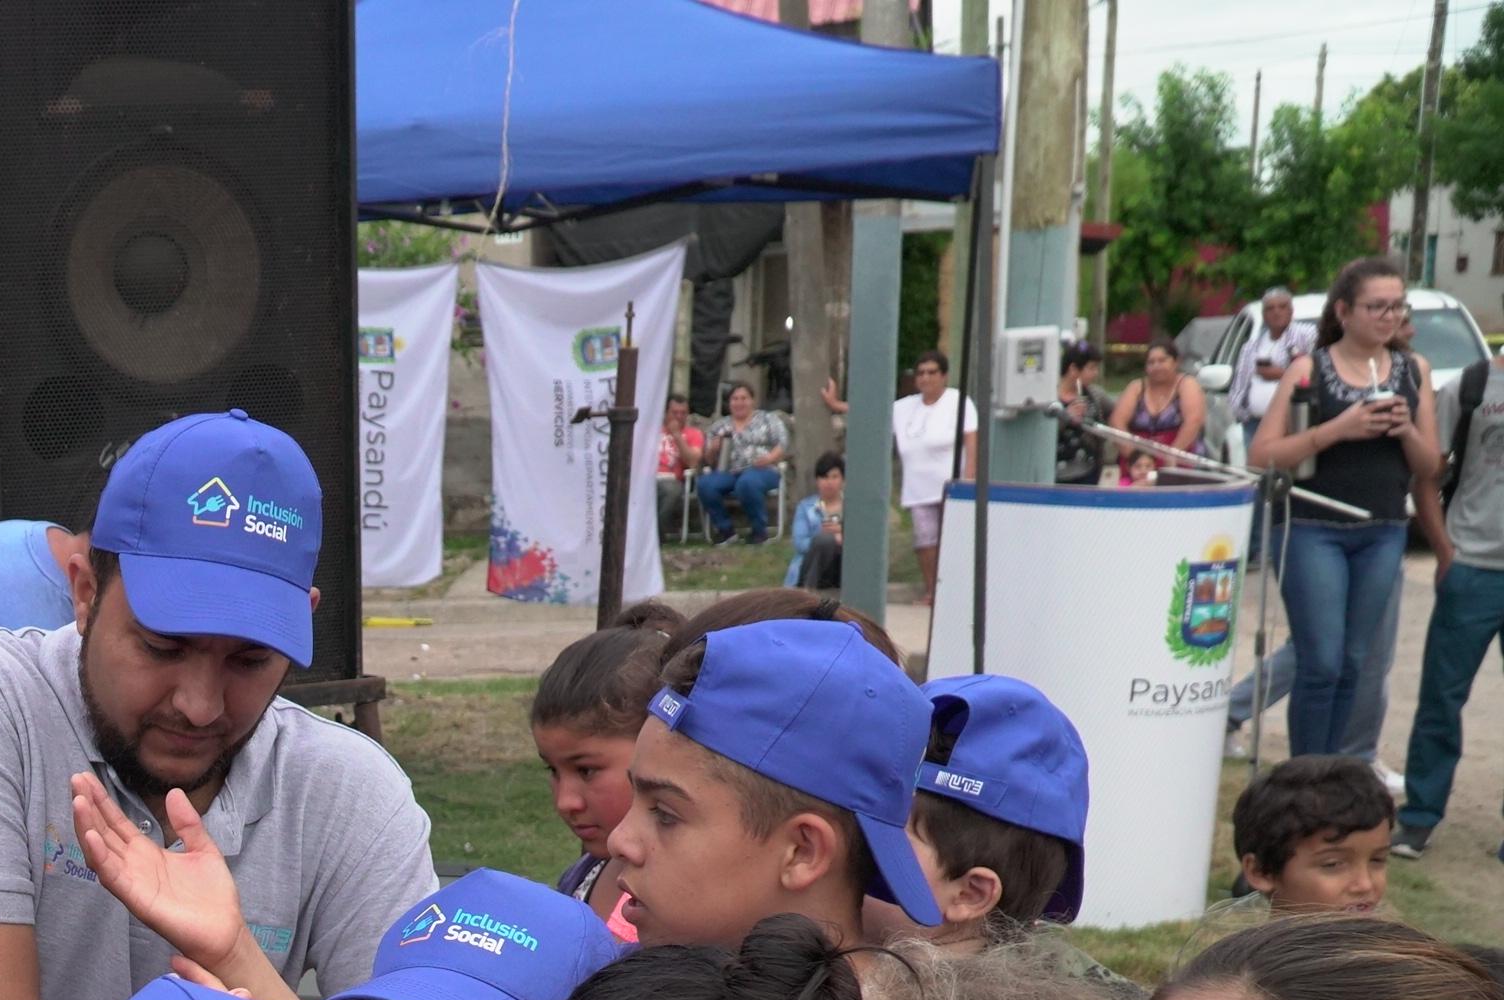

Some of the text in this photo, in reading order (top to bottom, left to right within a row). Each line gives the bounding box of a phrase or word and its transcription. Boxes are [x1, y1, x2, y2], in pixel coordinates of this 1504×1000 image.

[553, 379, 565, 448] SERVICIOS
[362, 368, 395, 531] Paysandú
[243, 514, 288, 542] Social
[247, 494, 304, 530] Inclusión
[948, 773, 984, 796] UTE
[64, 859, 97, 882] Social
[443, 924, 505, 956] Social
[452, 908, 539, 952] Inclusión
